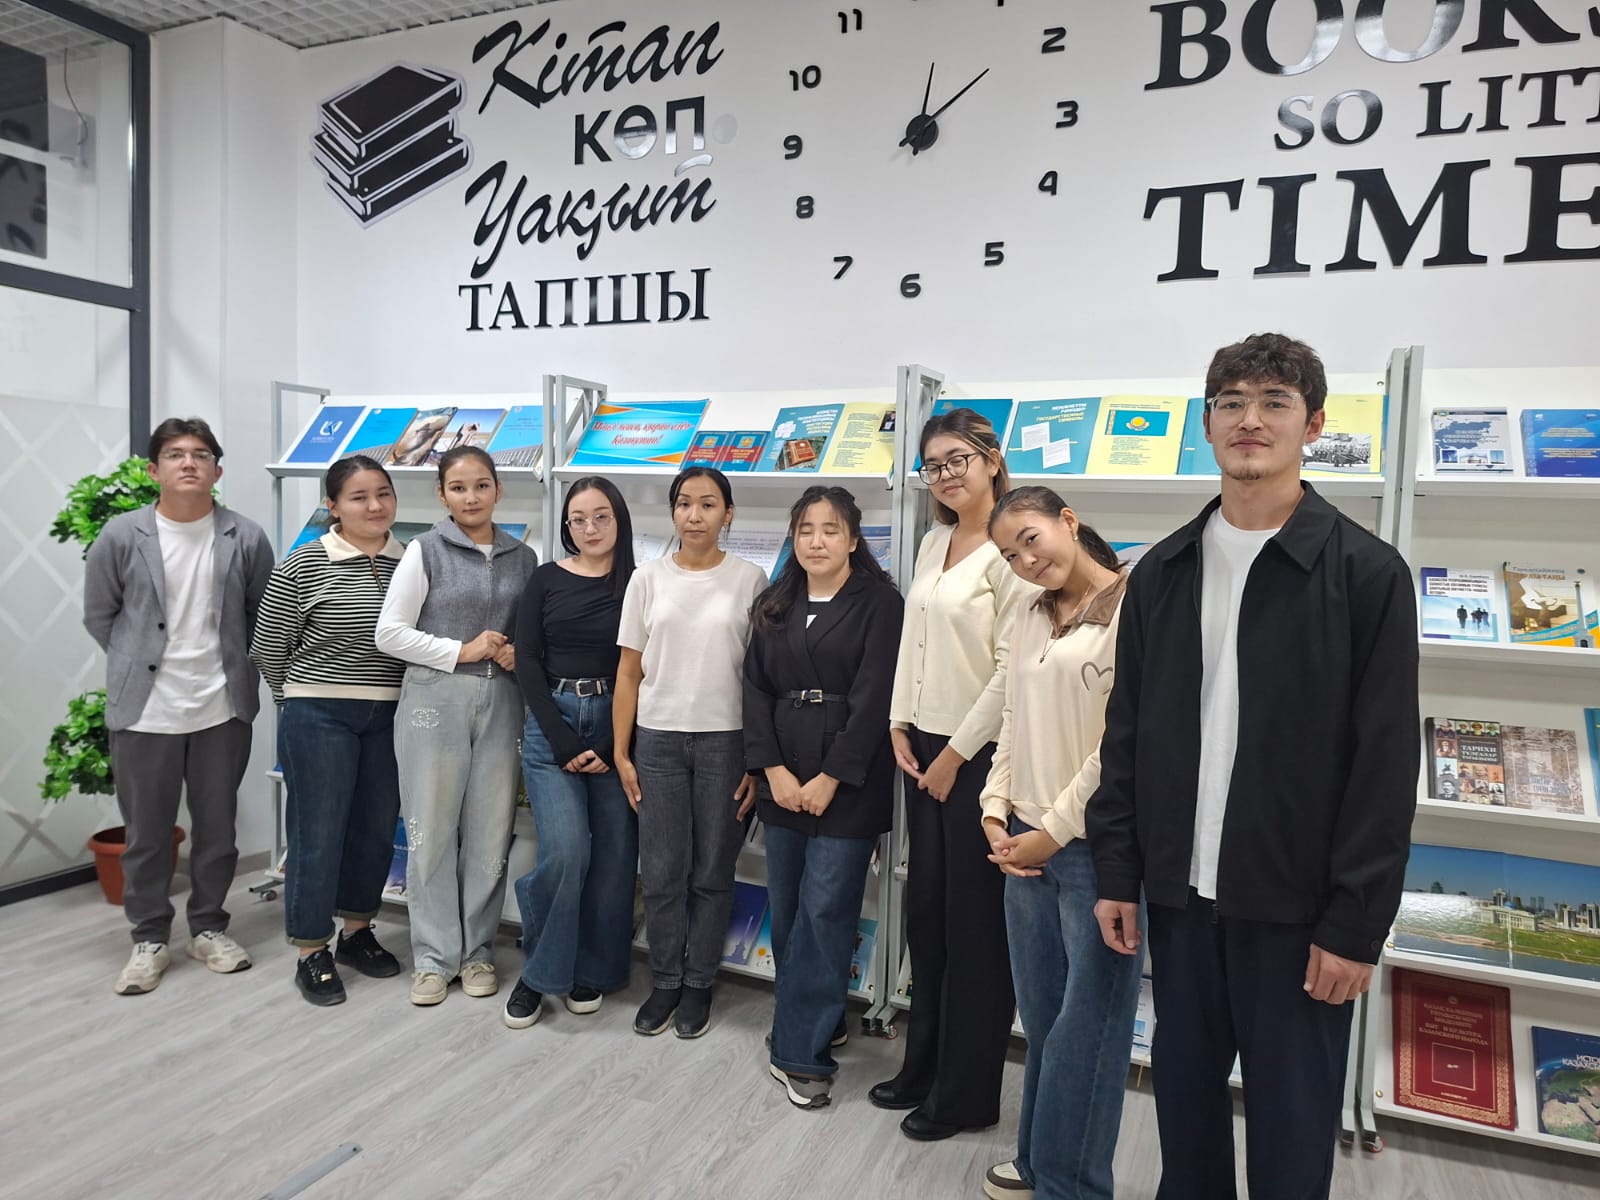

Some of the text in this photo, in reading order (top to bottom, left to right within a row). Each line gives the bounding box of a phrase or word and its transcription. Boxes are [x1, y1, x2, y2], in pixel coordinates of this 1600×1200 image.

[838, 9, 862, 34] 11
[1041, 27, 1067, 54] 2
[1144, 0, 1600, 91] BOOK
[472, 18, 725, 115] Кітап
[789, 65, 822, 92] 10
[1056, 100, 1079, 129] 3
[1274, 89, 1384, 150] SO
[783, 135, 803, 160] 9
[1038, 170, 1058, 196] 4
[796, 195, 815, 219] 8
[1143, 152, 1600, 284] TIME
[833, 255, 853, 280] 7
[984, 241, 1004, 267] 5
[900, 273, 922, 298] 6
[458, 268, 712, 332] ТАПШЫ
